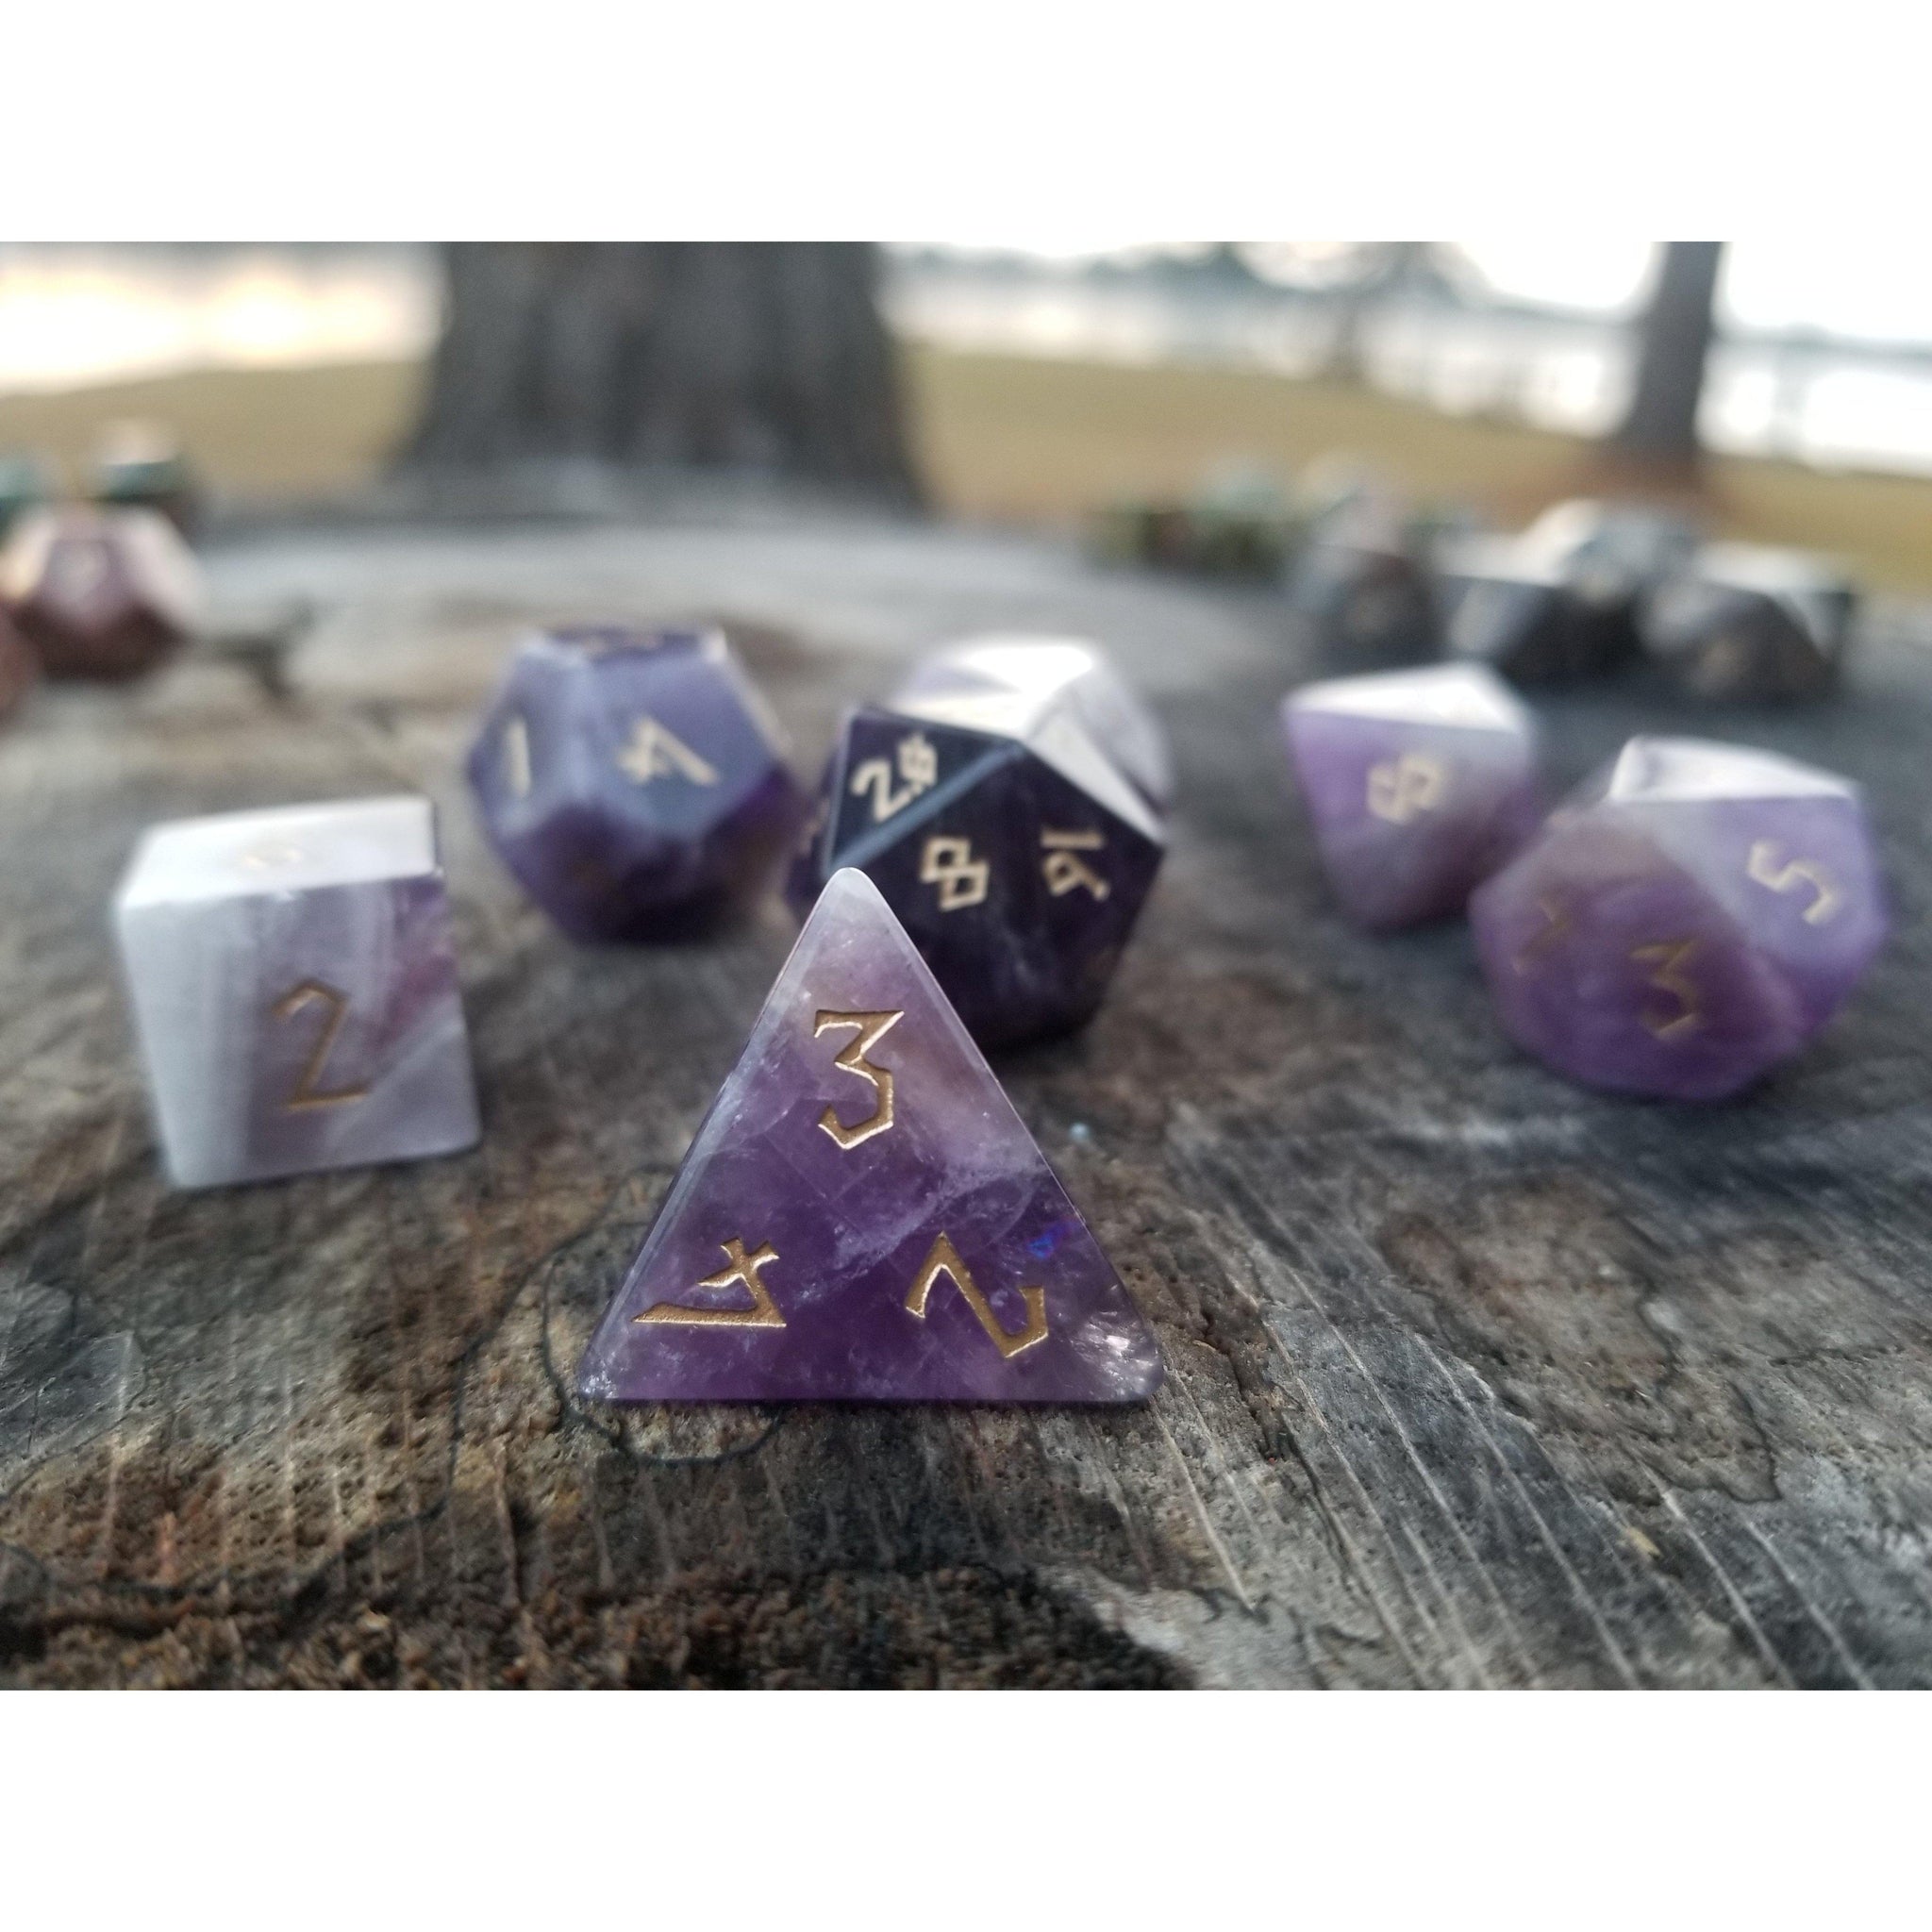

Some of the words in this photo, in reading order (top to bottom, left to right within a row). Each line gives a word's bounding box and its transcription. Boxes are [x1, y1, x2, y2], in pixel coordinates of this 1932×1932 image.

[852, 730, 939, 824] 20
[920, 836, 991, 912] 8
[1041, 829, 1110, 901] 16
[1745, 840, 1840, 925] 5
[1629, 939, 1702, 1041] 3
[272, 976, 374, 1112] 2
[814, 1008, 905, 1150] 3
[630, 1237, 787, 1328] 4
[904, 1230, 1049, 1358] 2
